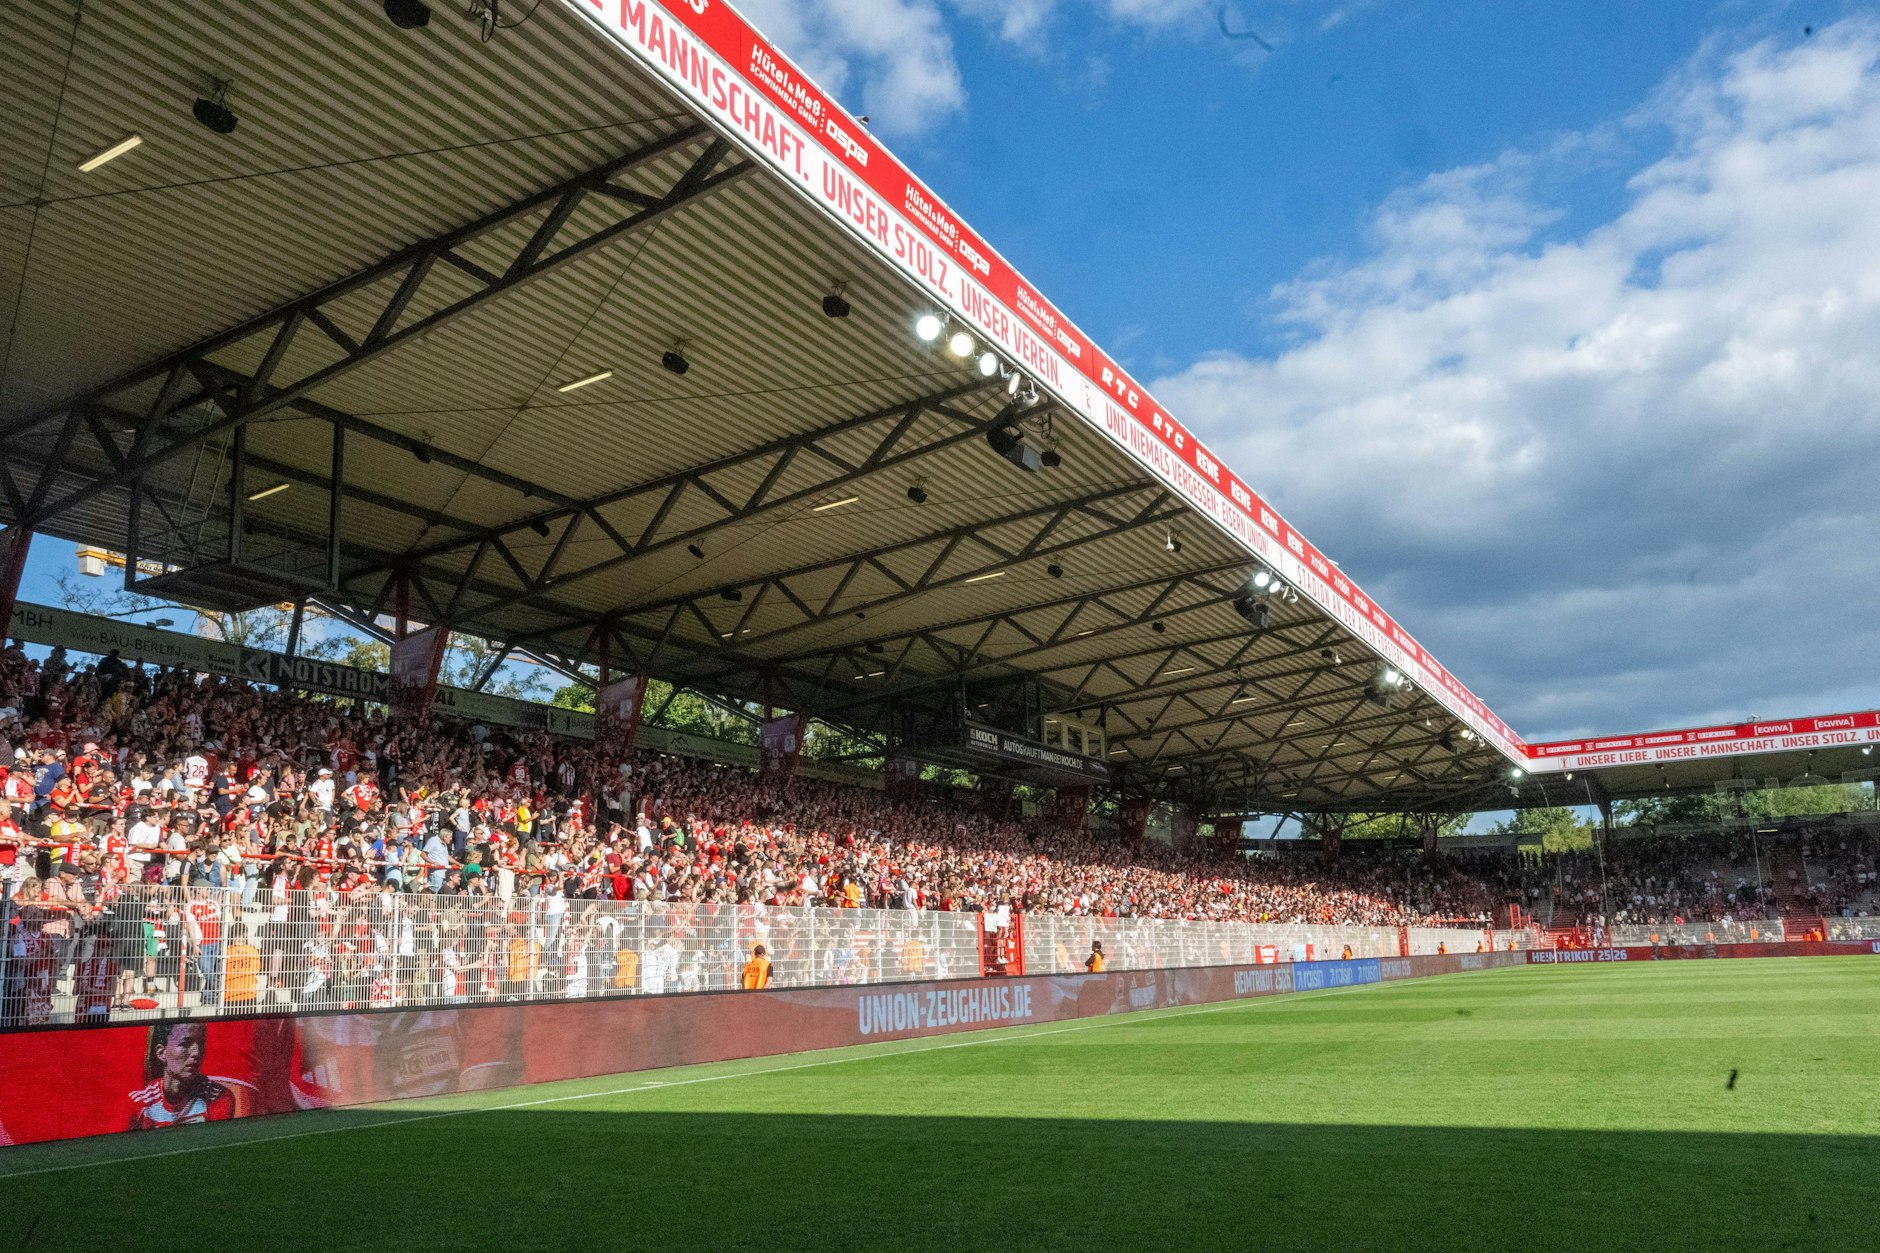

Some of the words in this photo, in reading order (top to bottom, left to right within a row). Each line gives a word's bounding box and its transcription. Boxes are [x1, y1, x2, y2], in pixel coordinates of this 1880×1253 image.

[750, 63, 797, 110] SCHWIMMBAD
[798, 106, 818, 128] GMBH
[752, 44, 821, 116] Hütel&Meß
[620, 0, 809, 181] MANNSCHAFT.
[823, 161, 888, 248] UNSER
[894, 223, 952, 298] STOLZ.
[961, 278, 1009, 345] UNSER
[1013, 322, 1062, 390] VEREIN.
[1105, 402, 1127, 441] UND
[1130, 422, 1170, 476] NIEMALS
[1222, 501, 1246, 538] EISERN
[1195, 447, 1219, 484] REWE
[1230, 479, 1251, 512] REWE
[1260, 506, 1279, 537] REWE
[1287, 530, 1304, 558] REWE
[278, 657, 389, 697] NOTSTROM
[976, 730, 998, 745] KOCH
[1577, 753, 1616, 766] UNSERE
[1620, 751, 1652, 762] LIEBE.
[1656, 746, 1696, 759] UNSERE
[1701, 739, 1778, 755] MANNSCHAFT.
[1782, 735, 1819, 748] UNSER
[1823, 731, 1861, 744] STOLZ.
[1532, 950, 1595, 962] HEIMTRIKOT
[1234, 969, 1274, 994] HEIMTRIKOT
[859, 985, 1032, 1035] UNION-ZEUGHAUS.DE
